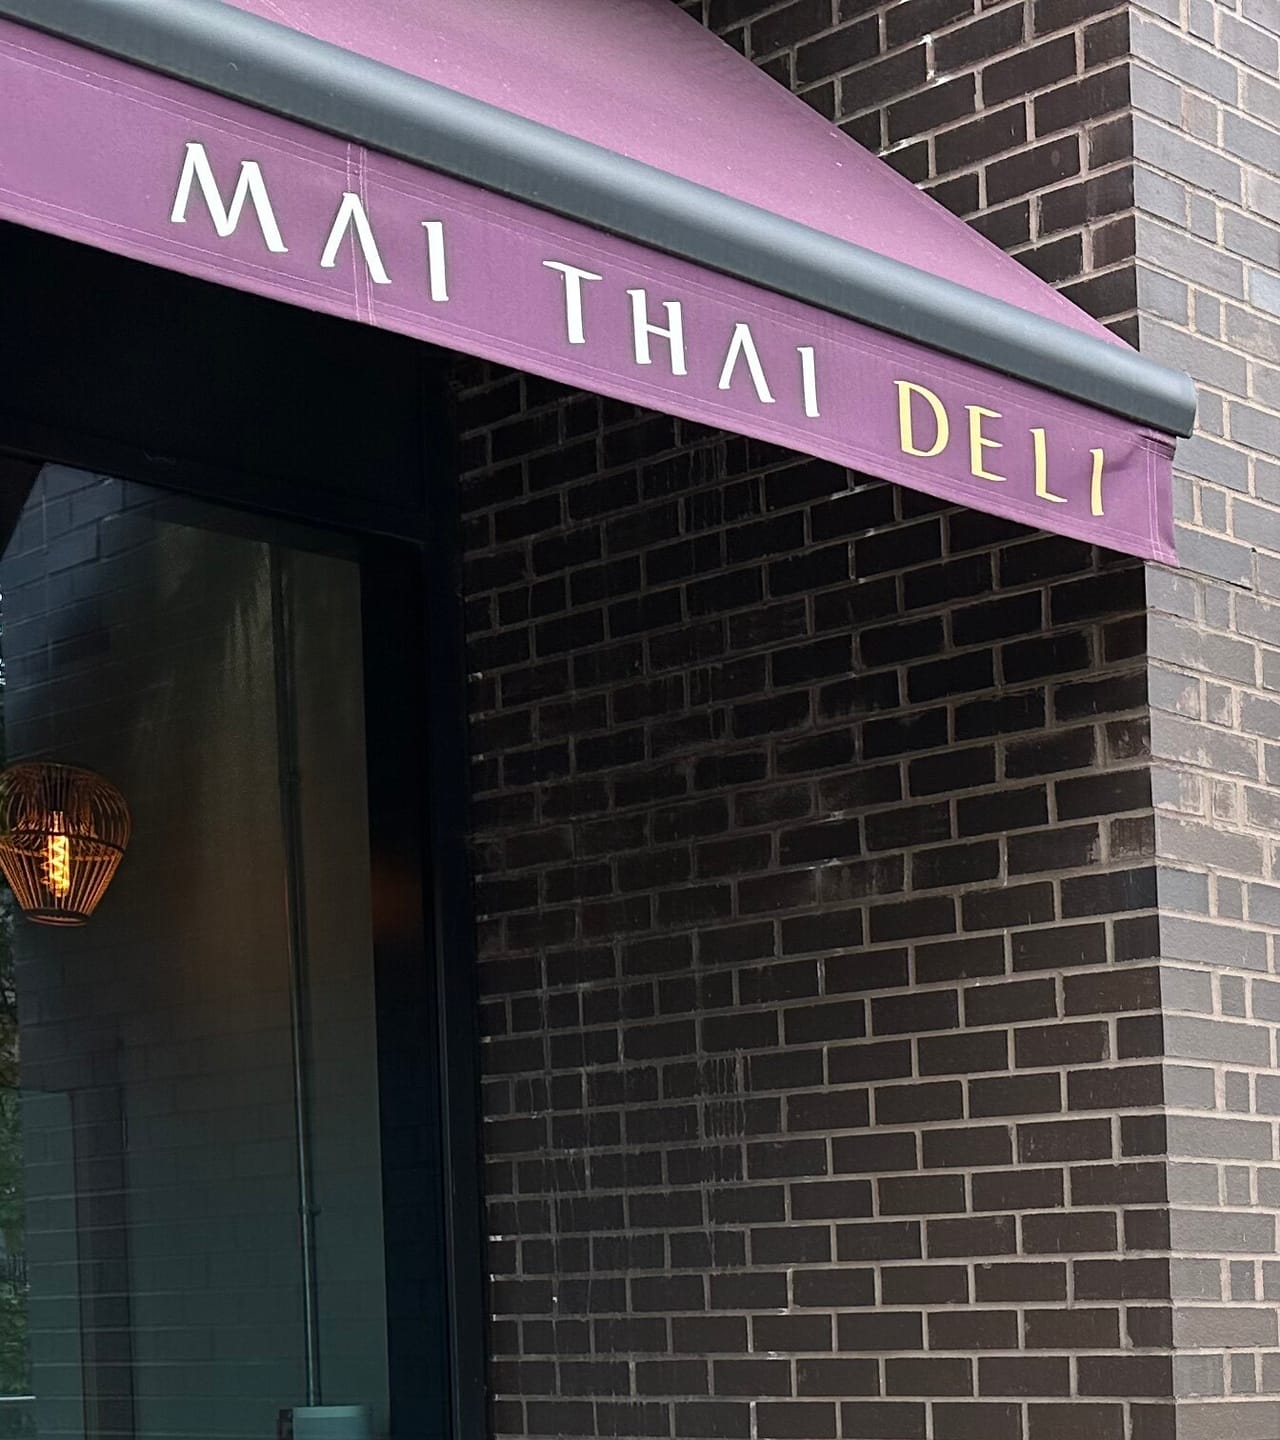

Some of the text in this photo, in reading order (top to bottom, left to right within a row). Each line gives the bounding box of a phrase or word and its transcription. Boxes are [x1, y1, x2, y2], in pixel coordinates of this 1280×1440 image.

[171, 142, 1104, 516] MAI THAI DELI
